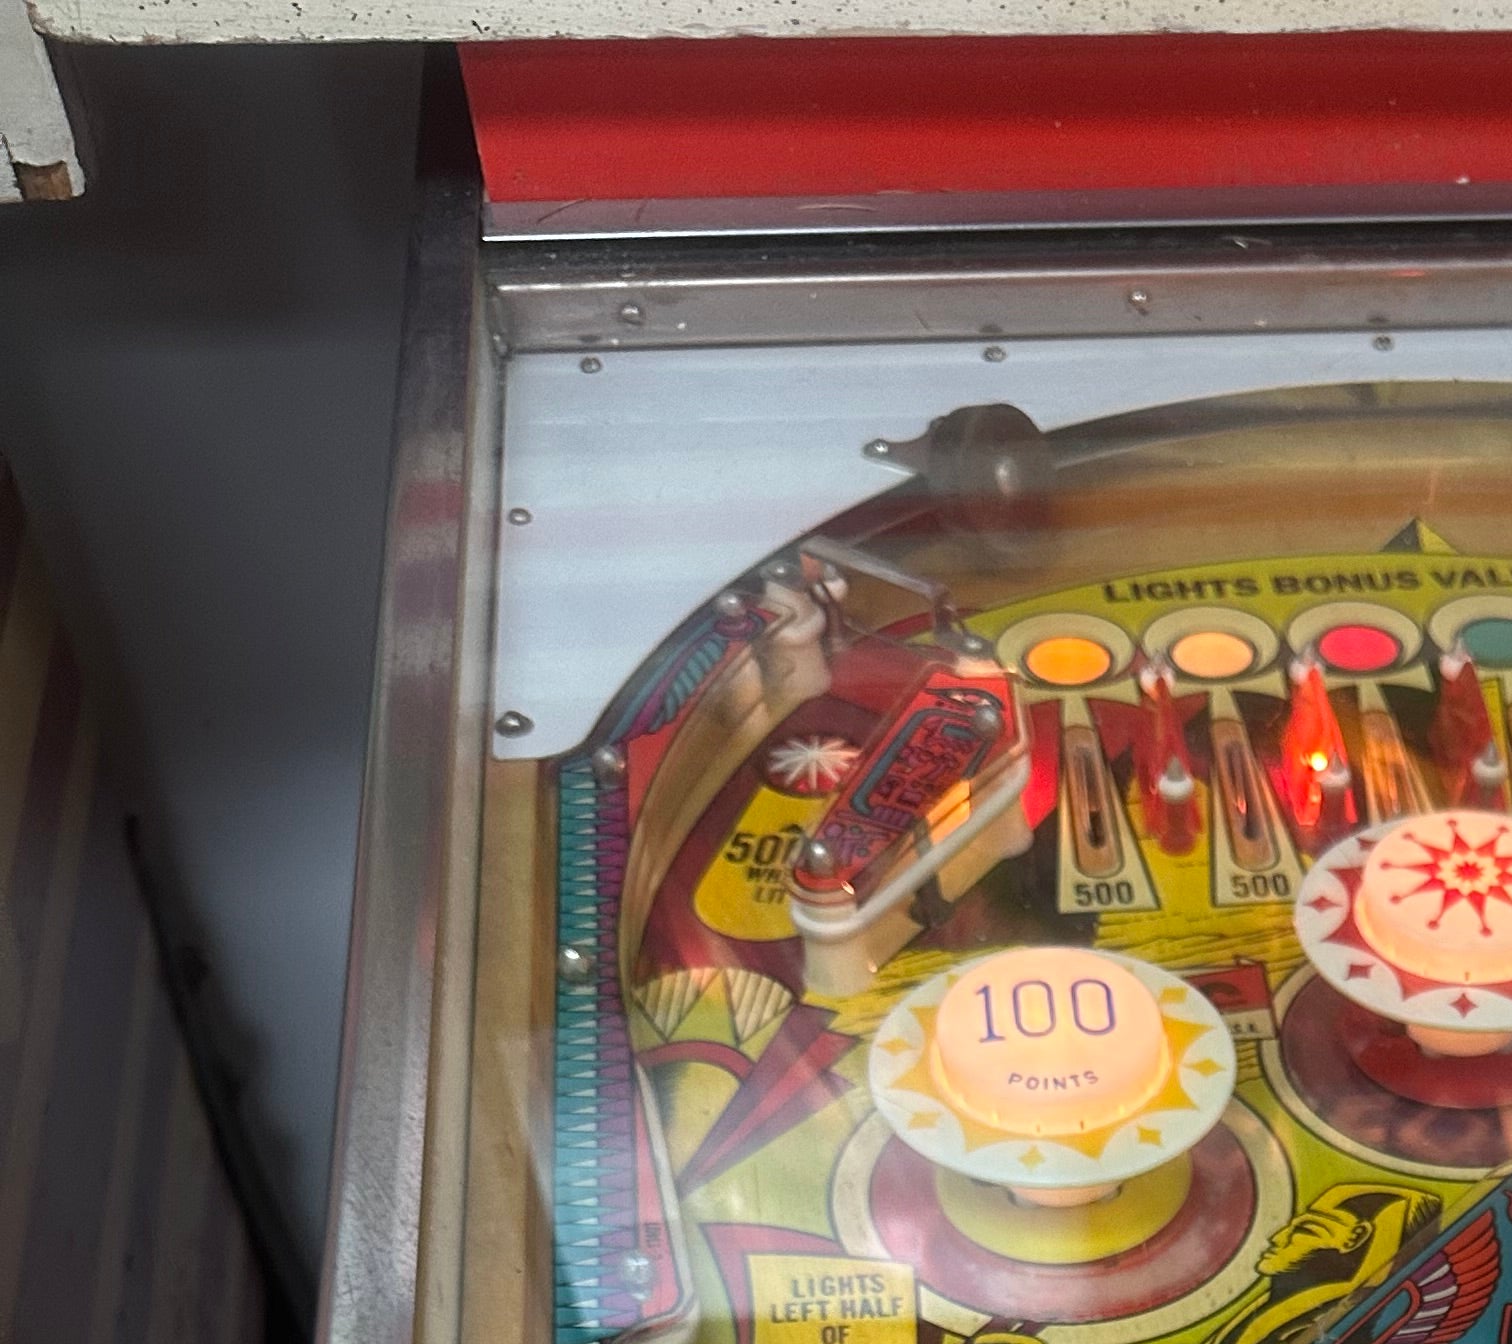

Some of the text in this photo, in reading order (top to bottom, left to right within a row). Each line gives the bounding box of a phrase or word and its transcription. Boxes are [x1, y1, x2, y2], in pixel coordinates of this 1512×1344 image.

[1103, 577, 1260, 603] LIGHTS
[1271, 571, 1419, 597] BONUS
[1074, 881, 1133, 906] 500
[1231, 873, 1290, 898] 500
[975, 979, 1116, 1043] 100
[1007, 1070, 1099, 1091] POINTS
[791, 1274, 885, 1298] LIGHTS
[770, 1297, 904, 1324] LEFT HALF
